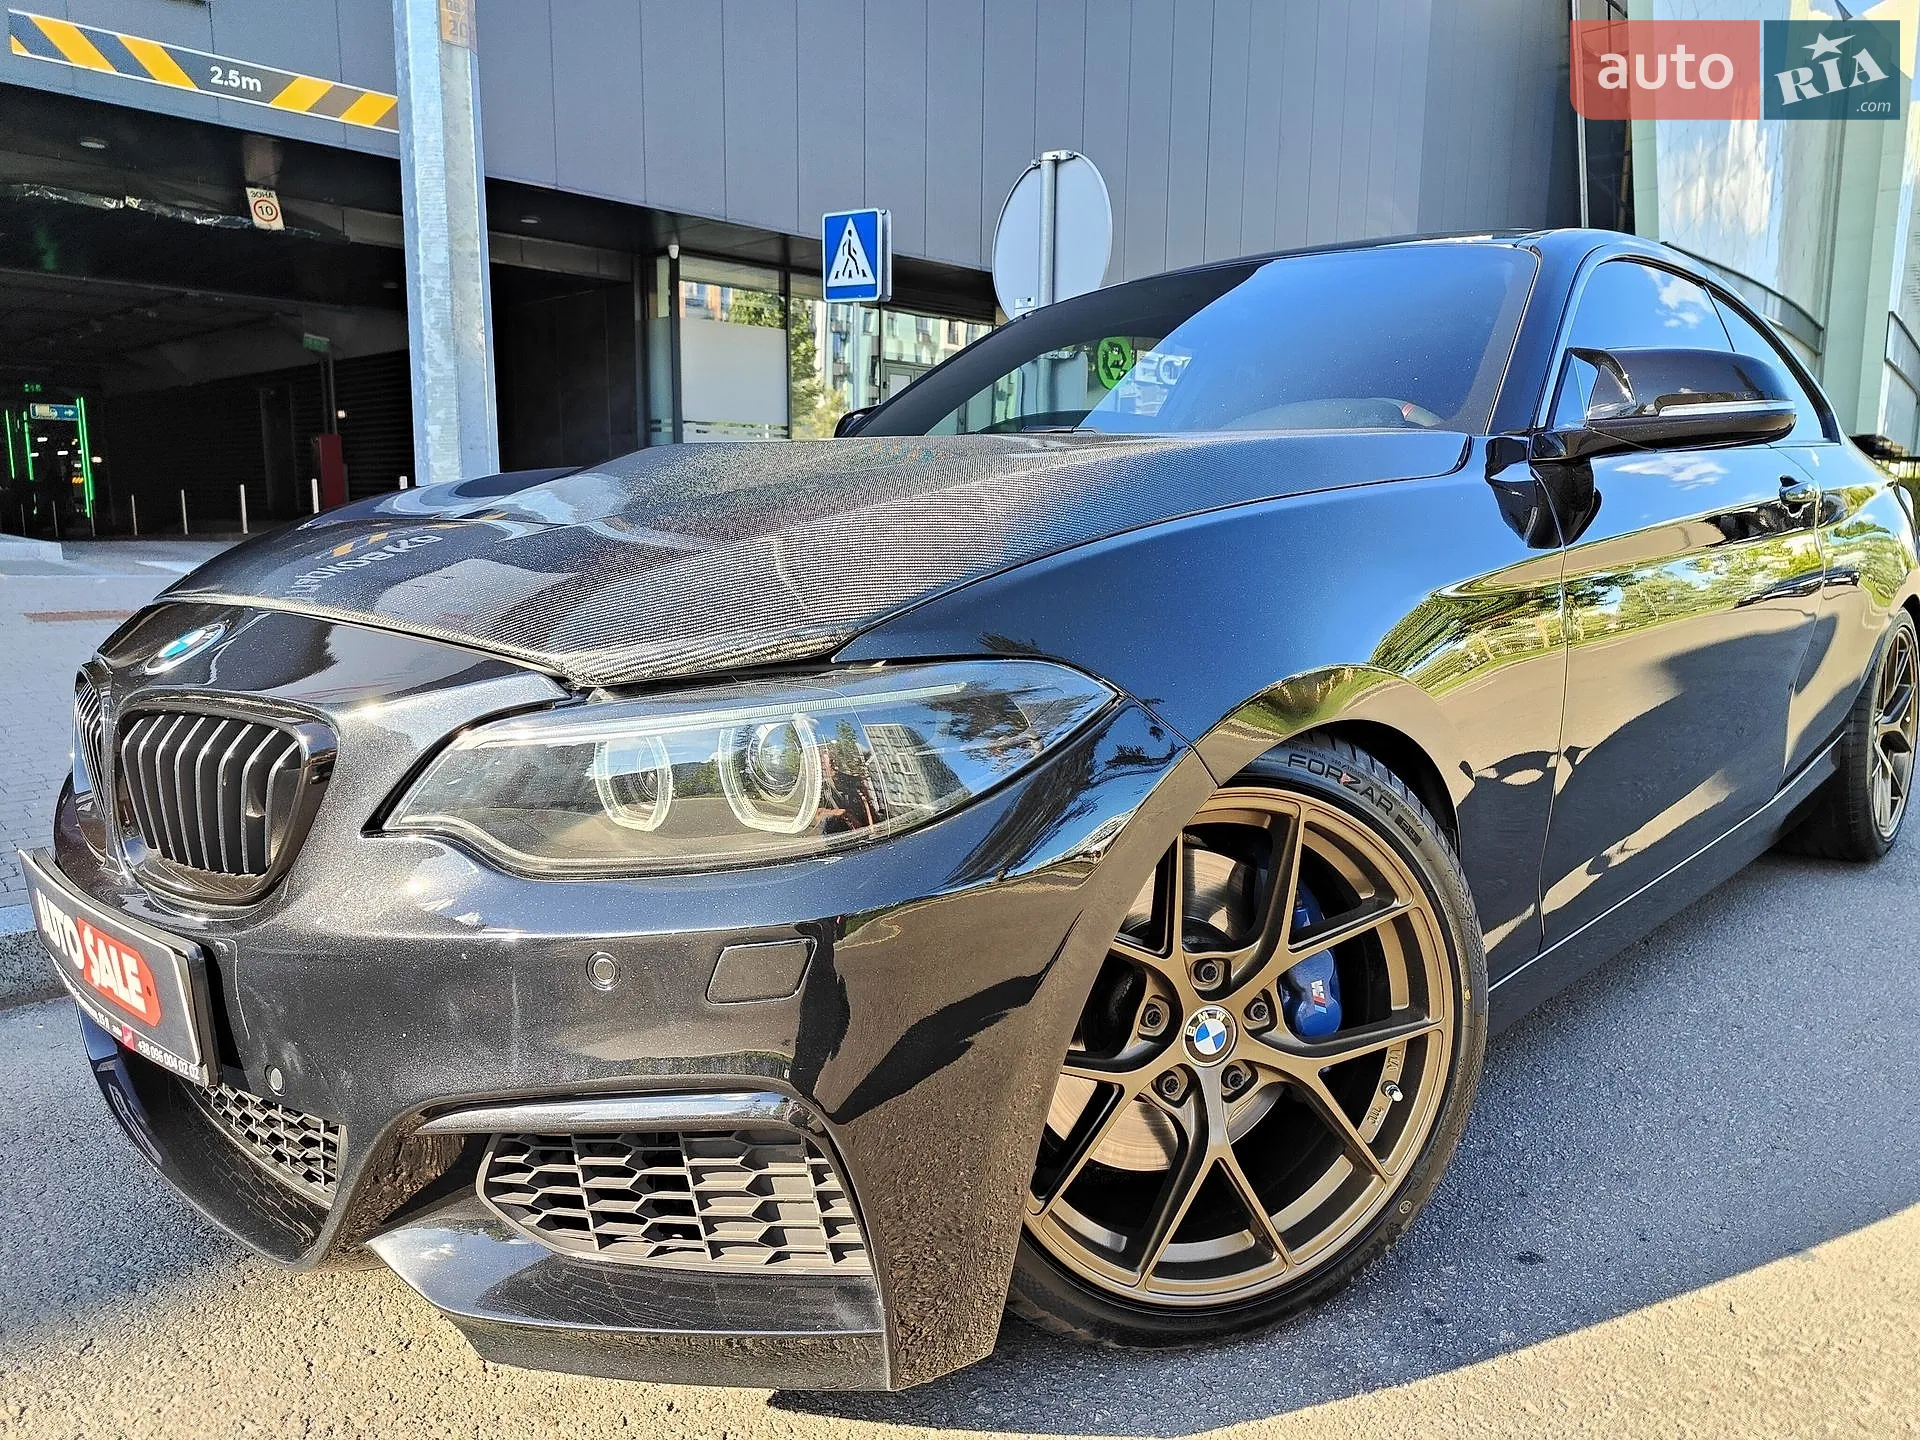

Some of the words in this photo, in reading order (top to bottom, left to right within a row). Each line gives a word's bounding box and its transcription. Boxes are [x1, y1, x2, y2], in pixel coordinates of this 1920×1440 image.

[210, 65, 262, 93] 2.5m
[250, 190, 274, 199] ЗОНА
[258, 205, 273, 216] 10
[35, 887, 85, 970] AUTO
[1185, 1010, 1226, 1037] BMW
[178, 1060, 189, 1076] 02
[189, 1065, 200, 1081] 02
